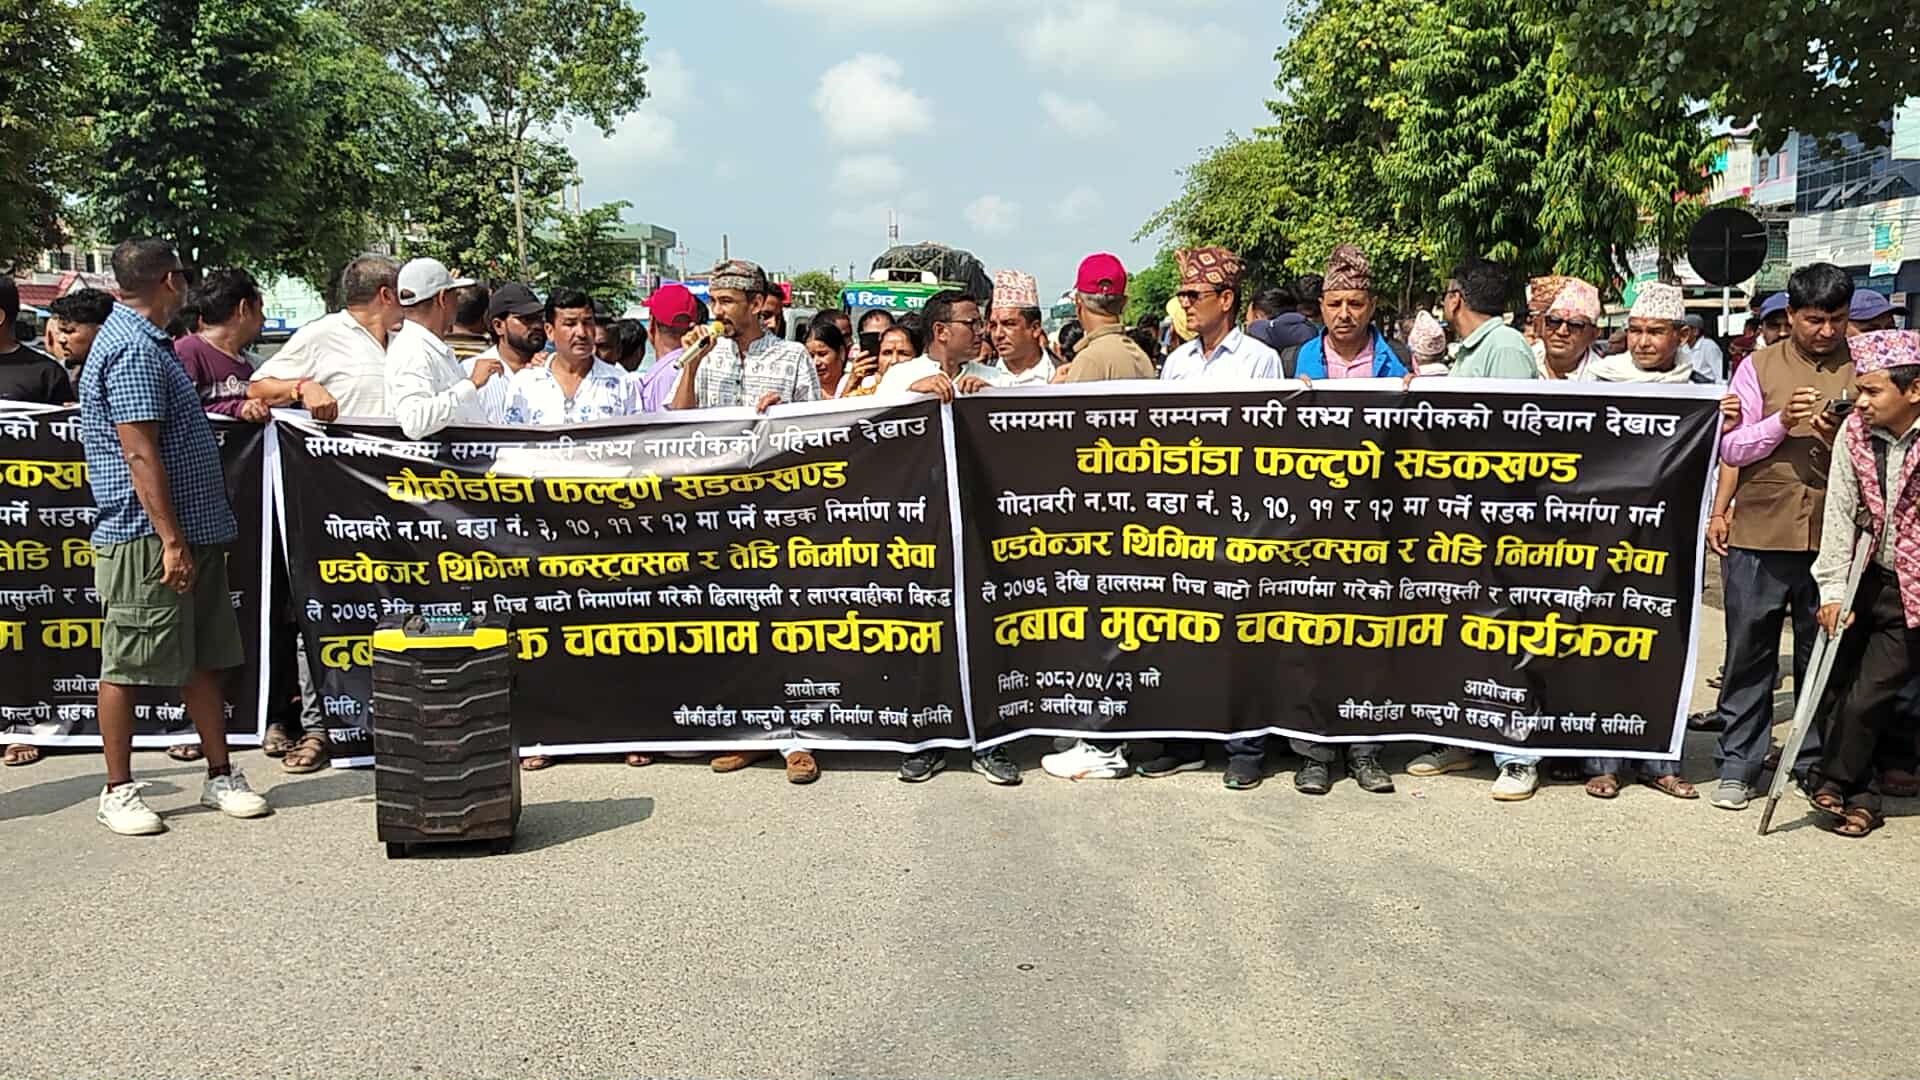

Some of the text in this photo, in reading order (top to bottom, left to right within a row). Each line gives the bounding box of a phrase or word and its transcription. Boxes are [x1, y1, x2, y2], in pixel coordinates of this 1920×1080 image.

[644, 428, 758, 458] नागरीकको
[769, 424, 851, 454] पहिचान
[860, 415, 928, 442] देखाउ
[989, 400, 1681, 437] समयमा काम सम्पन्न गरी सभ्य नागरीकको पहिचान देखाउ
[672, 460, 849, 500] सडकखण्ड
[1076, 437, 1582, 488] चौकीडाँडा फल्टुणे सडकखण्ड
[324, 513, 391, 541] गोदावरी
[397, 519, 448, 541] न.पा.
[456, 517, 498, 540] वडा
[505, 516, 529, 538] नं.
[638, 514, 654, 534] र
[662, 511, 687, 535] १२
[696, 509, 720, 531] मा
[727, 504, 758, 530] पर्ने
[763, 506, 817, 528] सडक
[824, 496, 890, 525] निर्माण
[898, 496, 926, 523] गर्न
[997, 487, 1076, 517] गोदावरी
[1084, 490, 1136, 513] न.पा.
[1147, 491, 1188, 514] वडा
[1197, 490, 1219, 515] नं.
[1344, 499, 1361, 522] र
[1369, 498, 1393, 523] १२
[1403, 496, 1429, 516] मा
[1438, 493, 1472, 521] पर्ने
[1480, 499, 1537, 524] सडक
[1545, 494, 1620, 525] निर्माण
[1629, 500, 1665, 528] गर्न
[318, 552, 430, 585] एडवेन्जर
[437, 550, 530, 584] थिगिम
[698, 550, 720, 571] र
[727, 540, 780, 571] तेडि
[787, 536, 880, 569] निर्माण
[886, 536, 937, 570] सेवा
[991, 526, 1114, 562] एडवेन्जर
[1122, 523, 1217, 563] थिगिम
[1398, 537, 1419, 564] र
[1427, 530, 1487, 567] तेडि
[1495, 534, 1599, 571] निर्माण
[1607, 541, 1669, 576] सेवा
[62, 588, 78, 605] र
[306, 600, 324, 622] ले
[494, 594, 527, 615] पिच
[534, 590, 571, 611] बाटो
[658, 586, 702, 606] गरेको
[708, 583, 783, 611] ढिलासुस्ती
[789, 588, 801, 606] र
[807, 582, 903, 607] लापरवाहीका
[981, 582, 998, 604] ले
[1055, 569, 1090, 593] देखि
[1097, 573, 1165, 595] हालसम्म
[1172, 573, 1206, 596] पिच
[1213, 579, 1251, 600] बाटो
[1343, 579, 1394, 600] गरेको
[1400, 577, 1482, 605] ढिलासुस्ती
[1489, 585, 1502, 605] र
[1509, 584, 1615, 612] लापरवाहीका
[561, 620, 760, 658] चक्काजाम
[771, 610, 944, 654] कार्यक्रम
[993, 606, 1658, 662] दबाव मुलक चक्काजाम कार्यक्रम
[784, 678, 840, 698] आयोजक
[1139, 667, 1161, 688] गते
[1464, 679, 1528, 703] आयोजक
[829, 703, 873, 725] निर्माण
[1098, 697, 1128, 718] चोक
[1465, 710, 1504, 730] सडक
[1601, 713, 1648, 737] समिति
